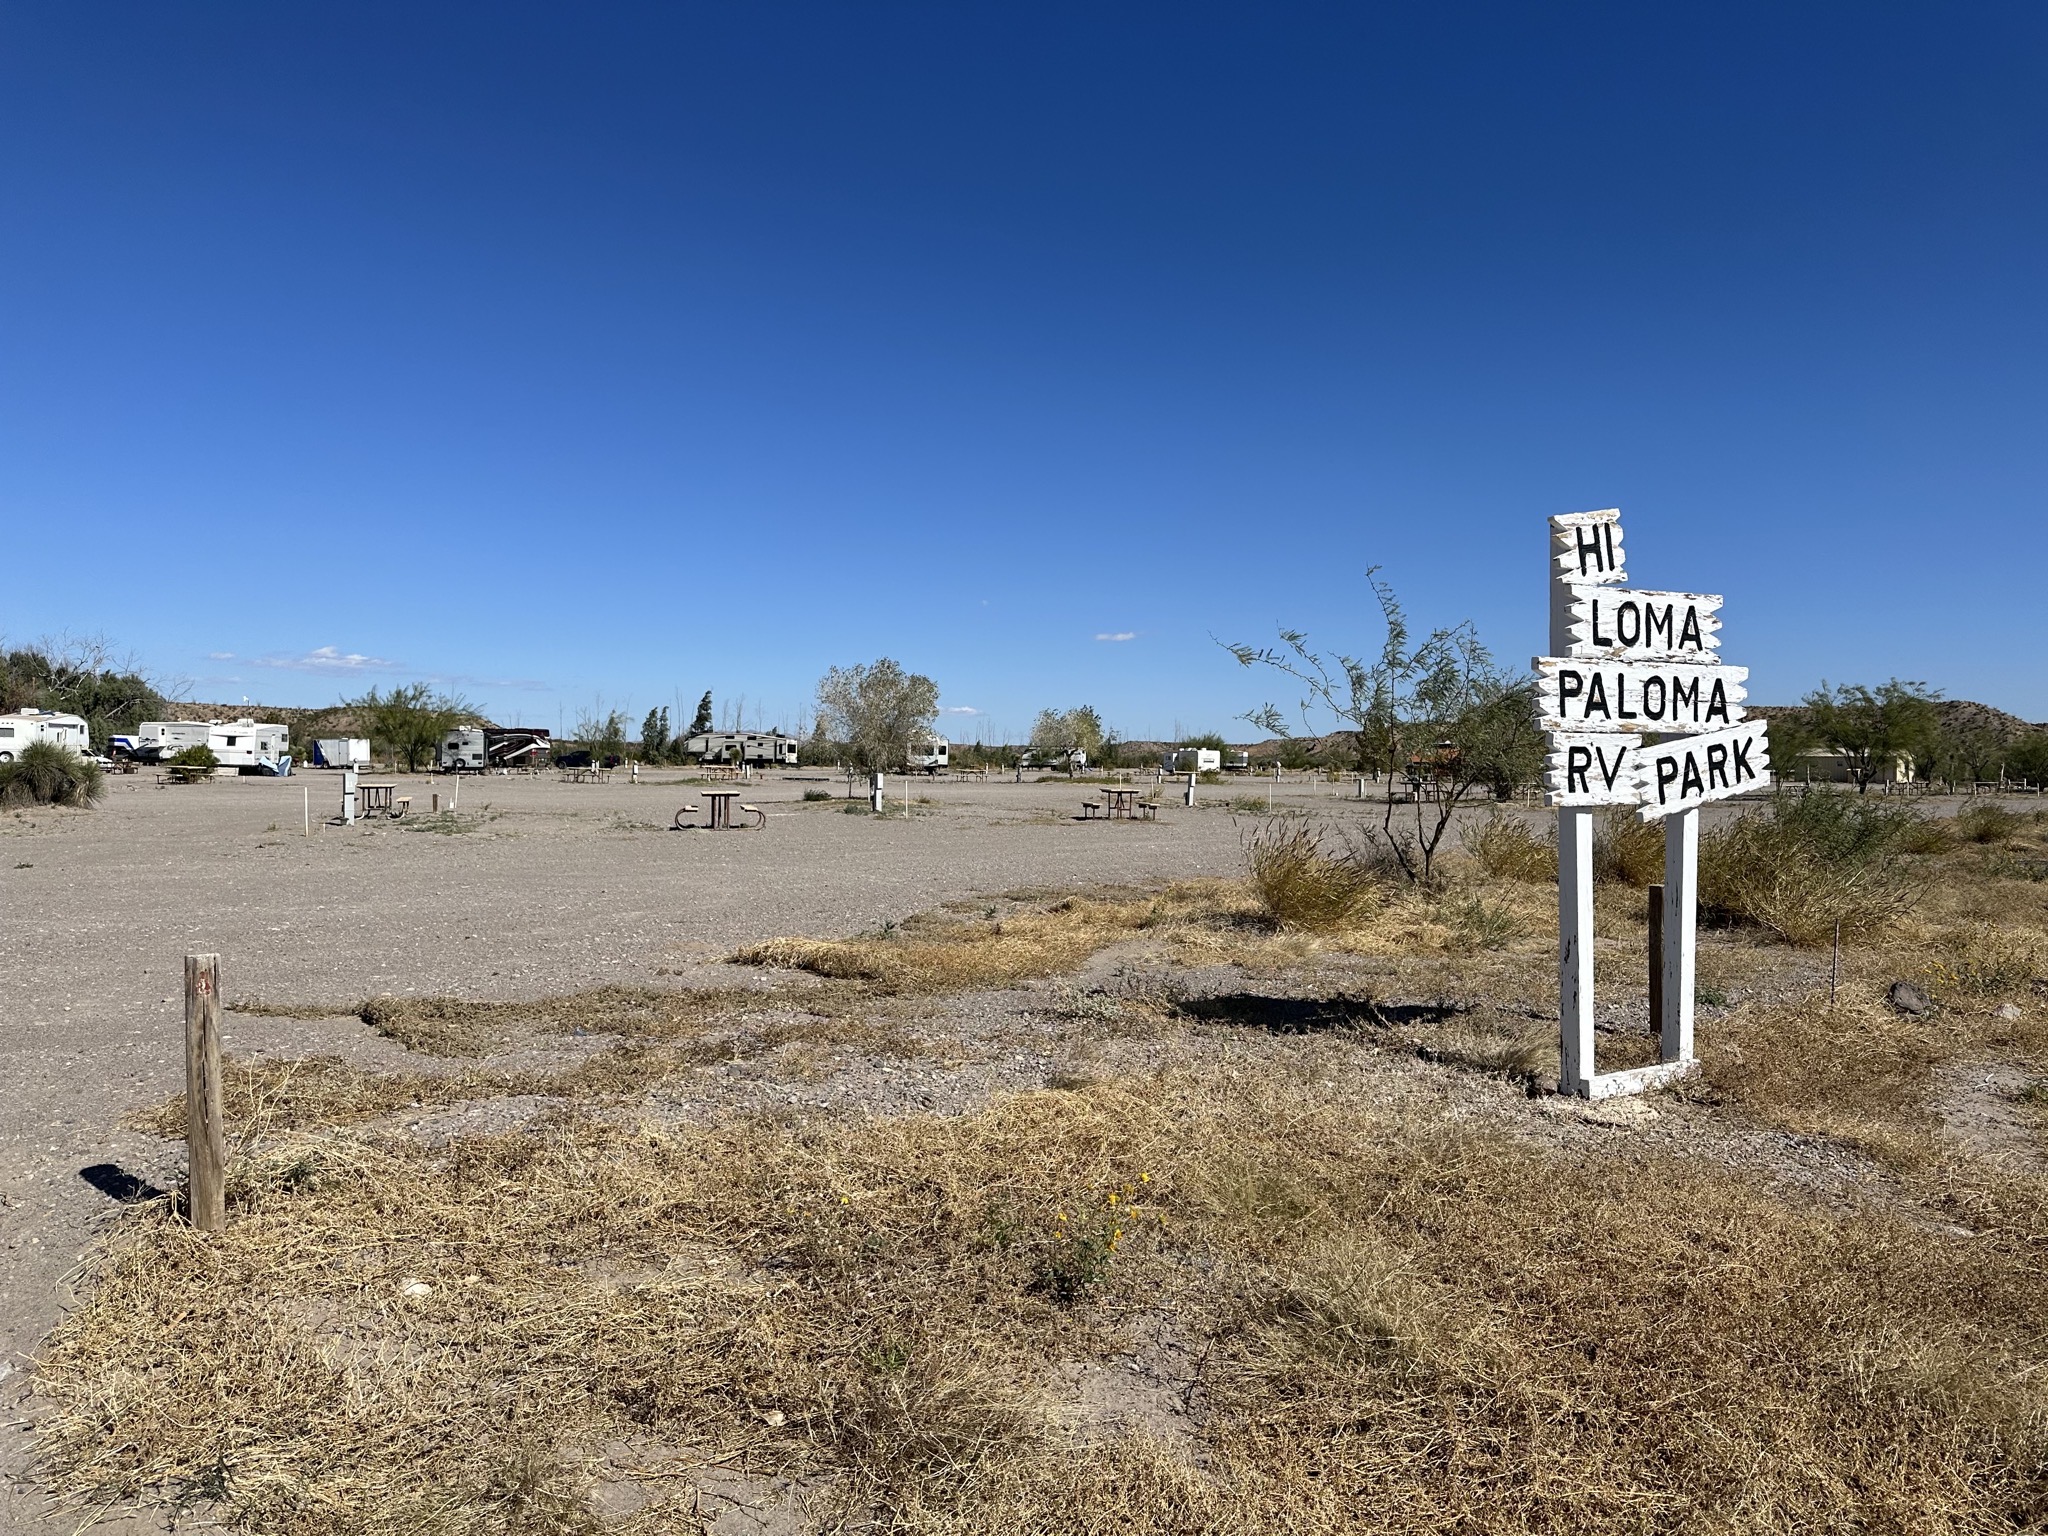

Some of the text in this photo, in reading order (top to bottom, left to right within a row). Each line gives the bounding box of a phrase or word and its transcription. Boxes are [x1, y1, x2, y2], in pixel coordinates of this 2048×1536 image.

[1576, 523, 1615, 577] HI
[1593, 599, 1703, 650] LOMA
[1559, 670, 1729, 723] PALOMA
[1568, 736, 1756, 805] RV PARK
